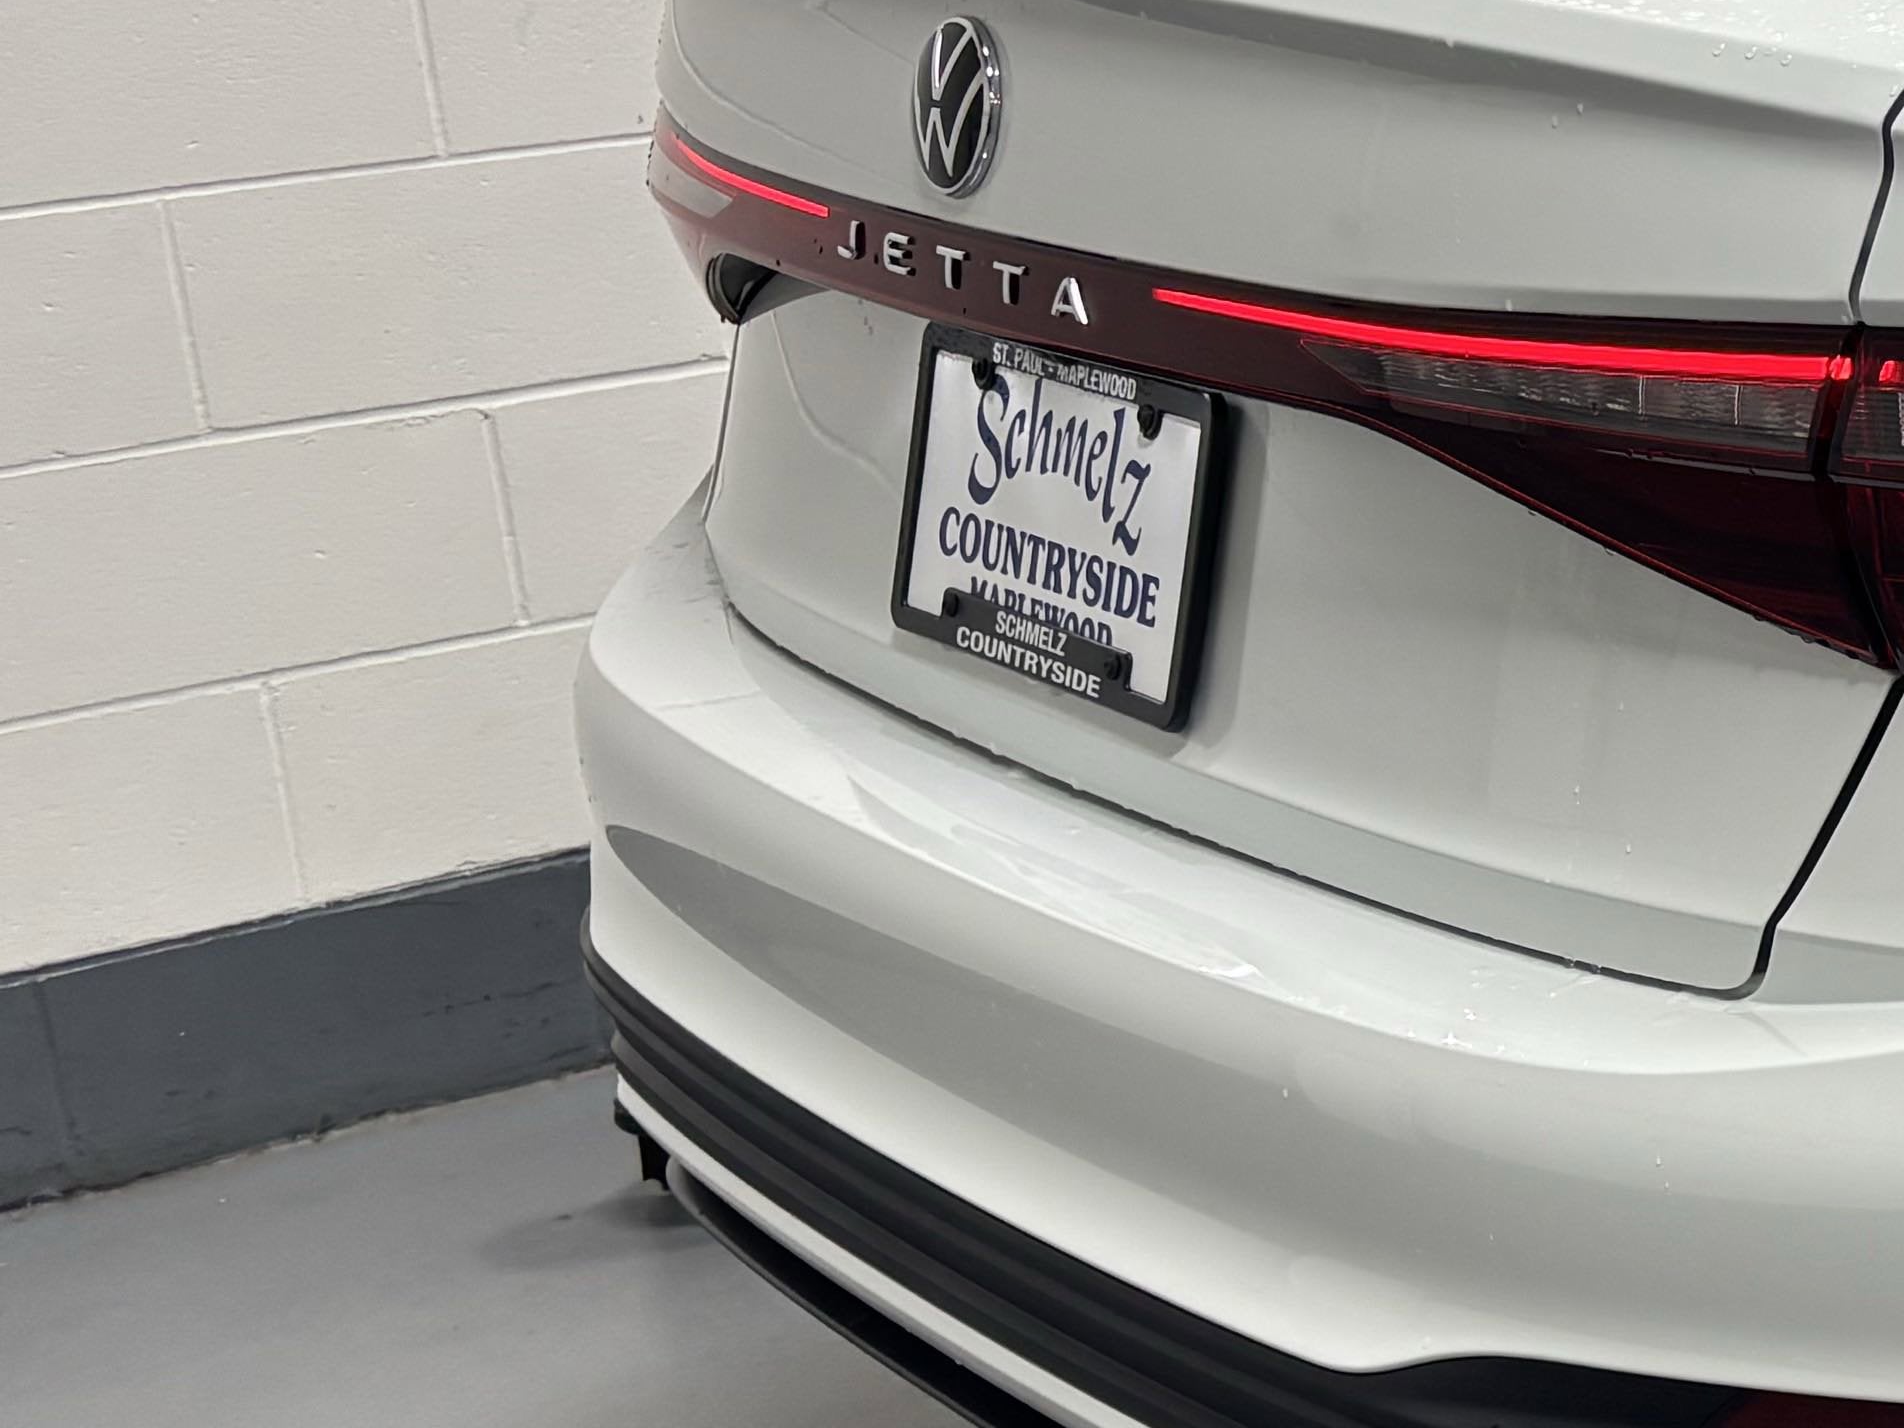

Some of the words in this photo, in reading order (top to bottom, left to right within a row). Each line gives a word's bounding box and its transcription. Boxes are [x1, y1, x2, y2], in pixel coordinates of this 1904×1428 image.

[837, 220, 1089, 325] JETTA
[993, 342, 1012, 366] ST.
[1014, 348, 1045, 376] PAUL
[1056, 363, 1137, 400] MAPLEWOOD
[968, 377, 1151, 556] Schmelz
[939, 506, 1161, 629] COUNTRYSIDE
[956, 626, 1102, 699] COUNTRYSIDE
[995, 610, 1068, 657] SCHMELZ
